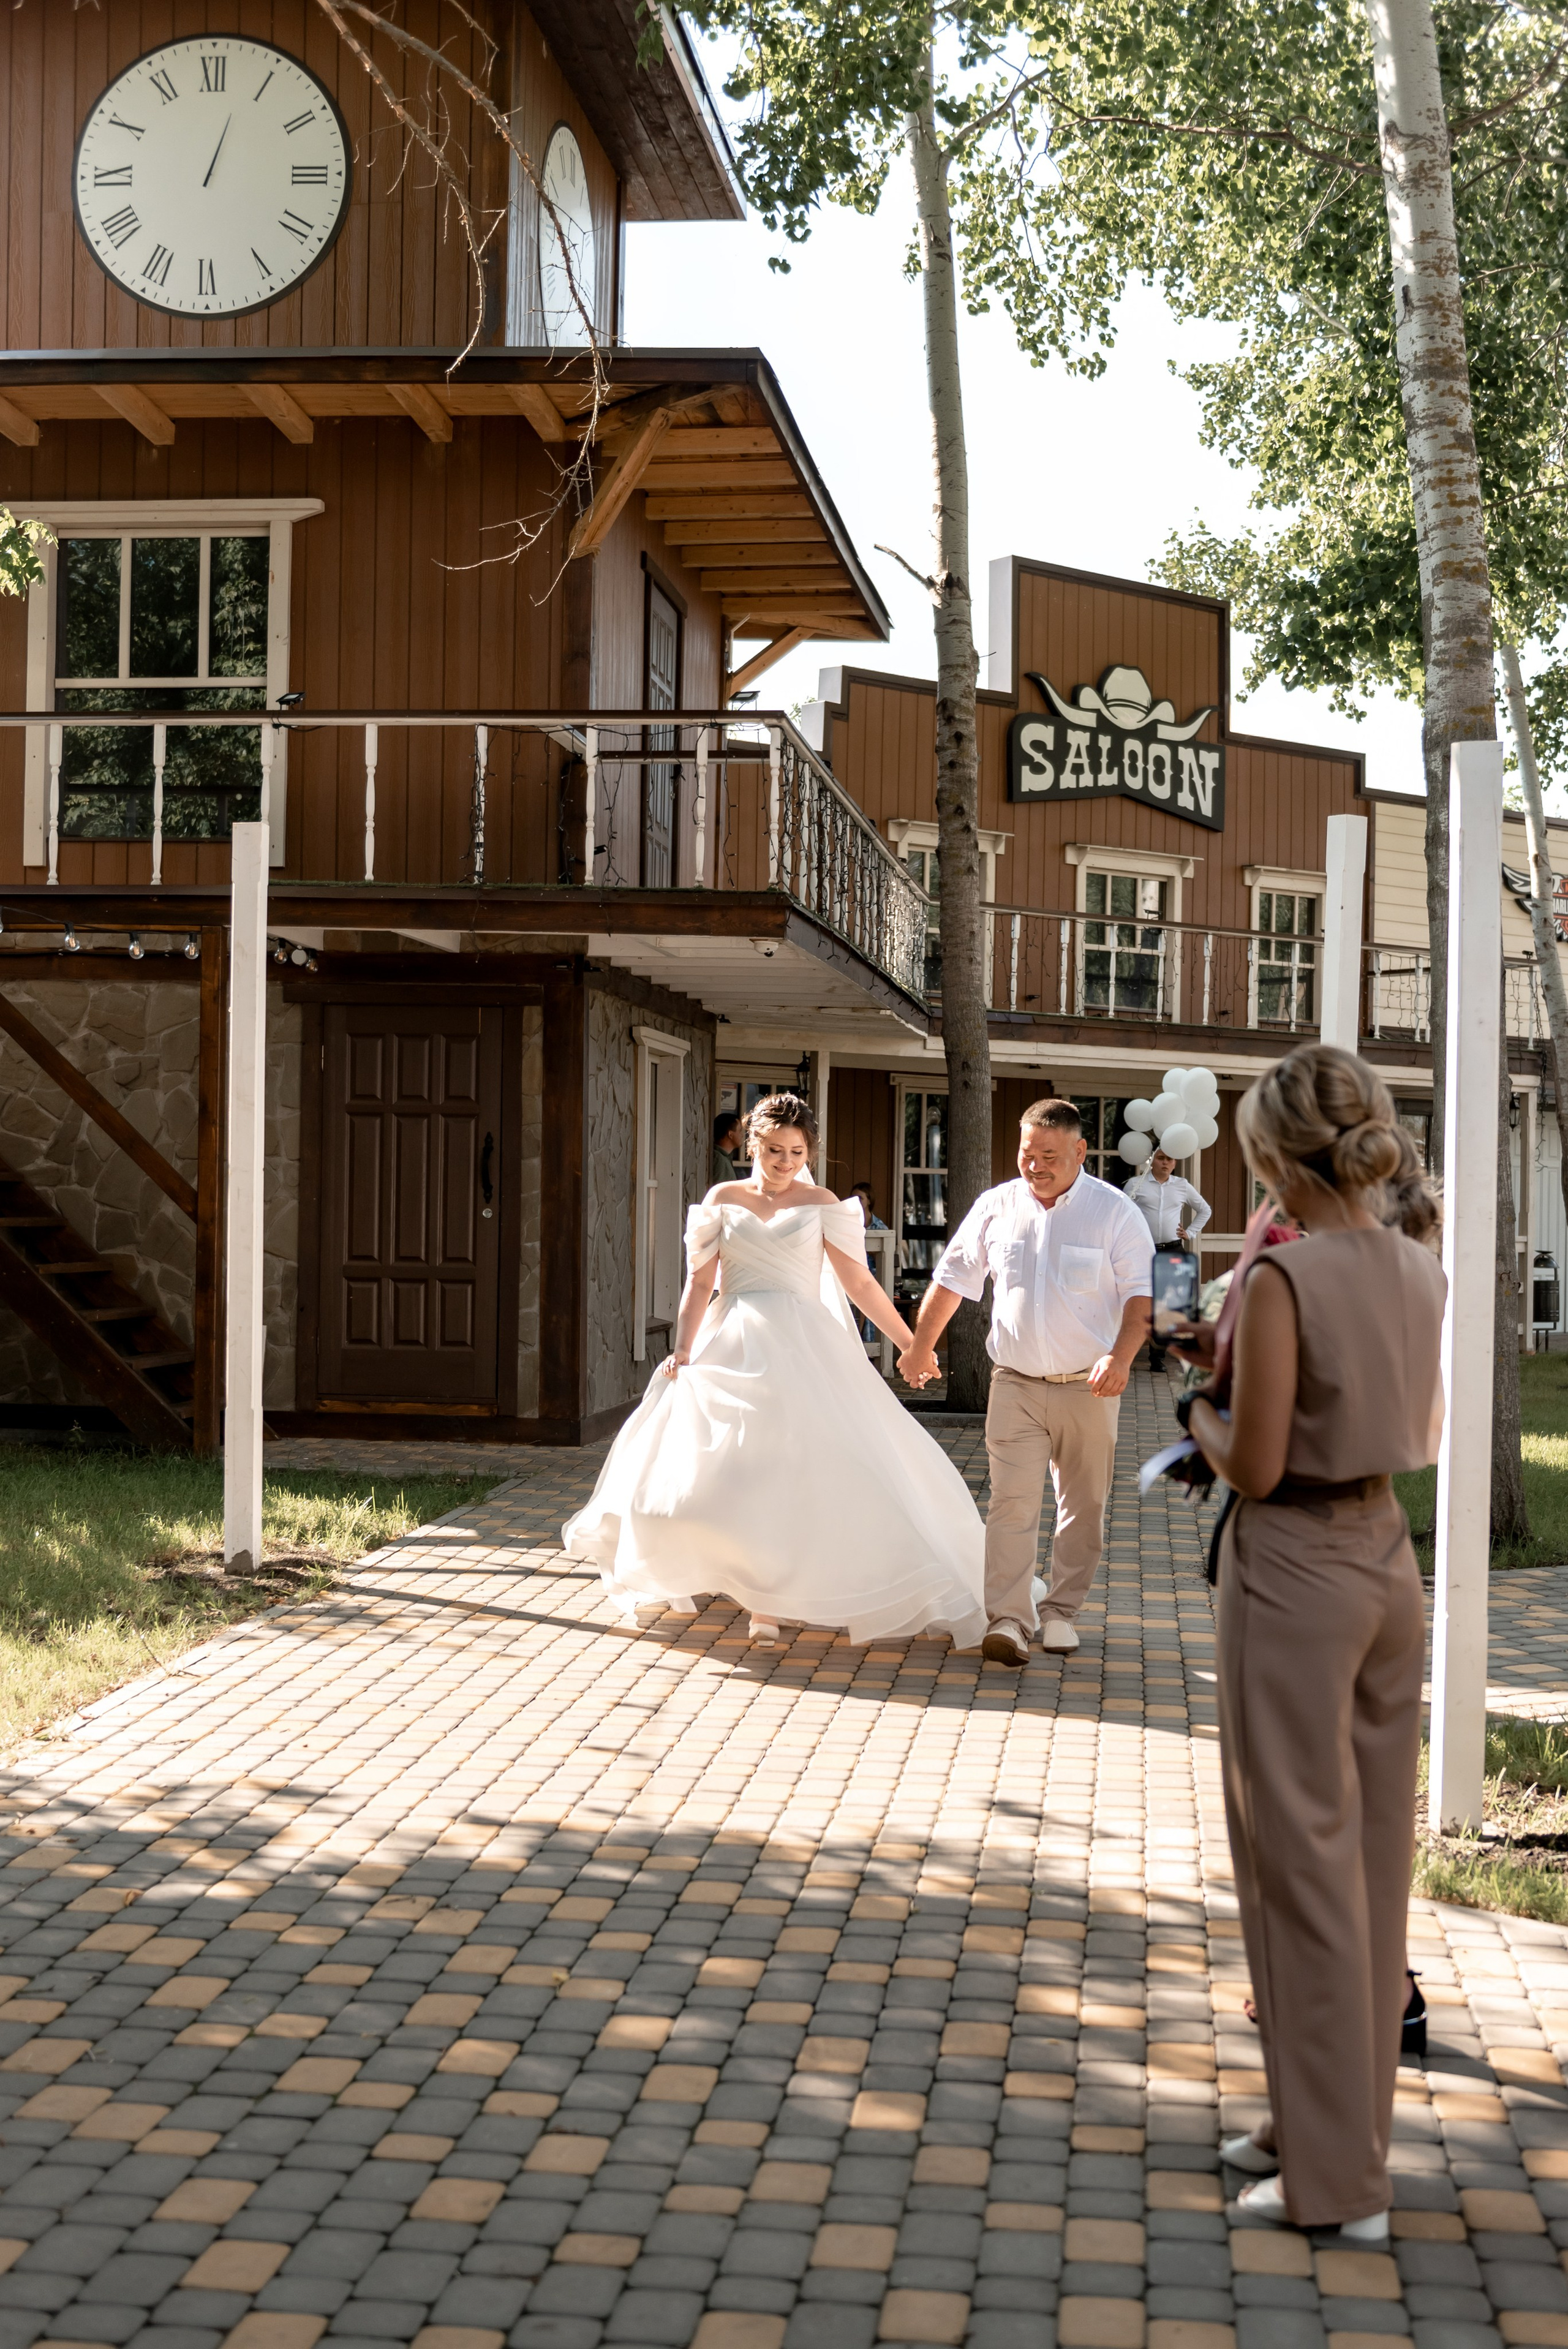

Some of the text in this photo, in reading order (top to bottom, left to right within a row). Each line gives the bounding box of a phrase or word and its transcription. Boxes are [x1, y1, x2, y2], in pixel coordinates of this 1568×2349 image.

[149, 69, 179, 105] XI
[199, 56, 227, 92] XII
[253, 70, 275, 102] I
[108, 112, 146, 141] X
[283, 109, 316, 135] II
[94, 165, 132, 187] IX
[292, 165, 328, 186] III
[101, 205, 141, 250] VIII
[278, 209, 314, 246] IV
[141, 244, 174, 287] VII
[198, 258, 217, 295] VI
[251, 247, 273, 280] V
[1020, 723, 1219, 818] SALOON
